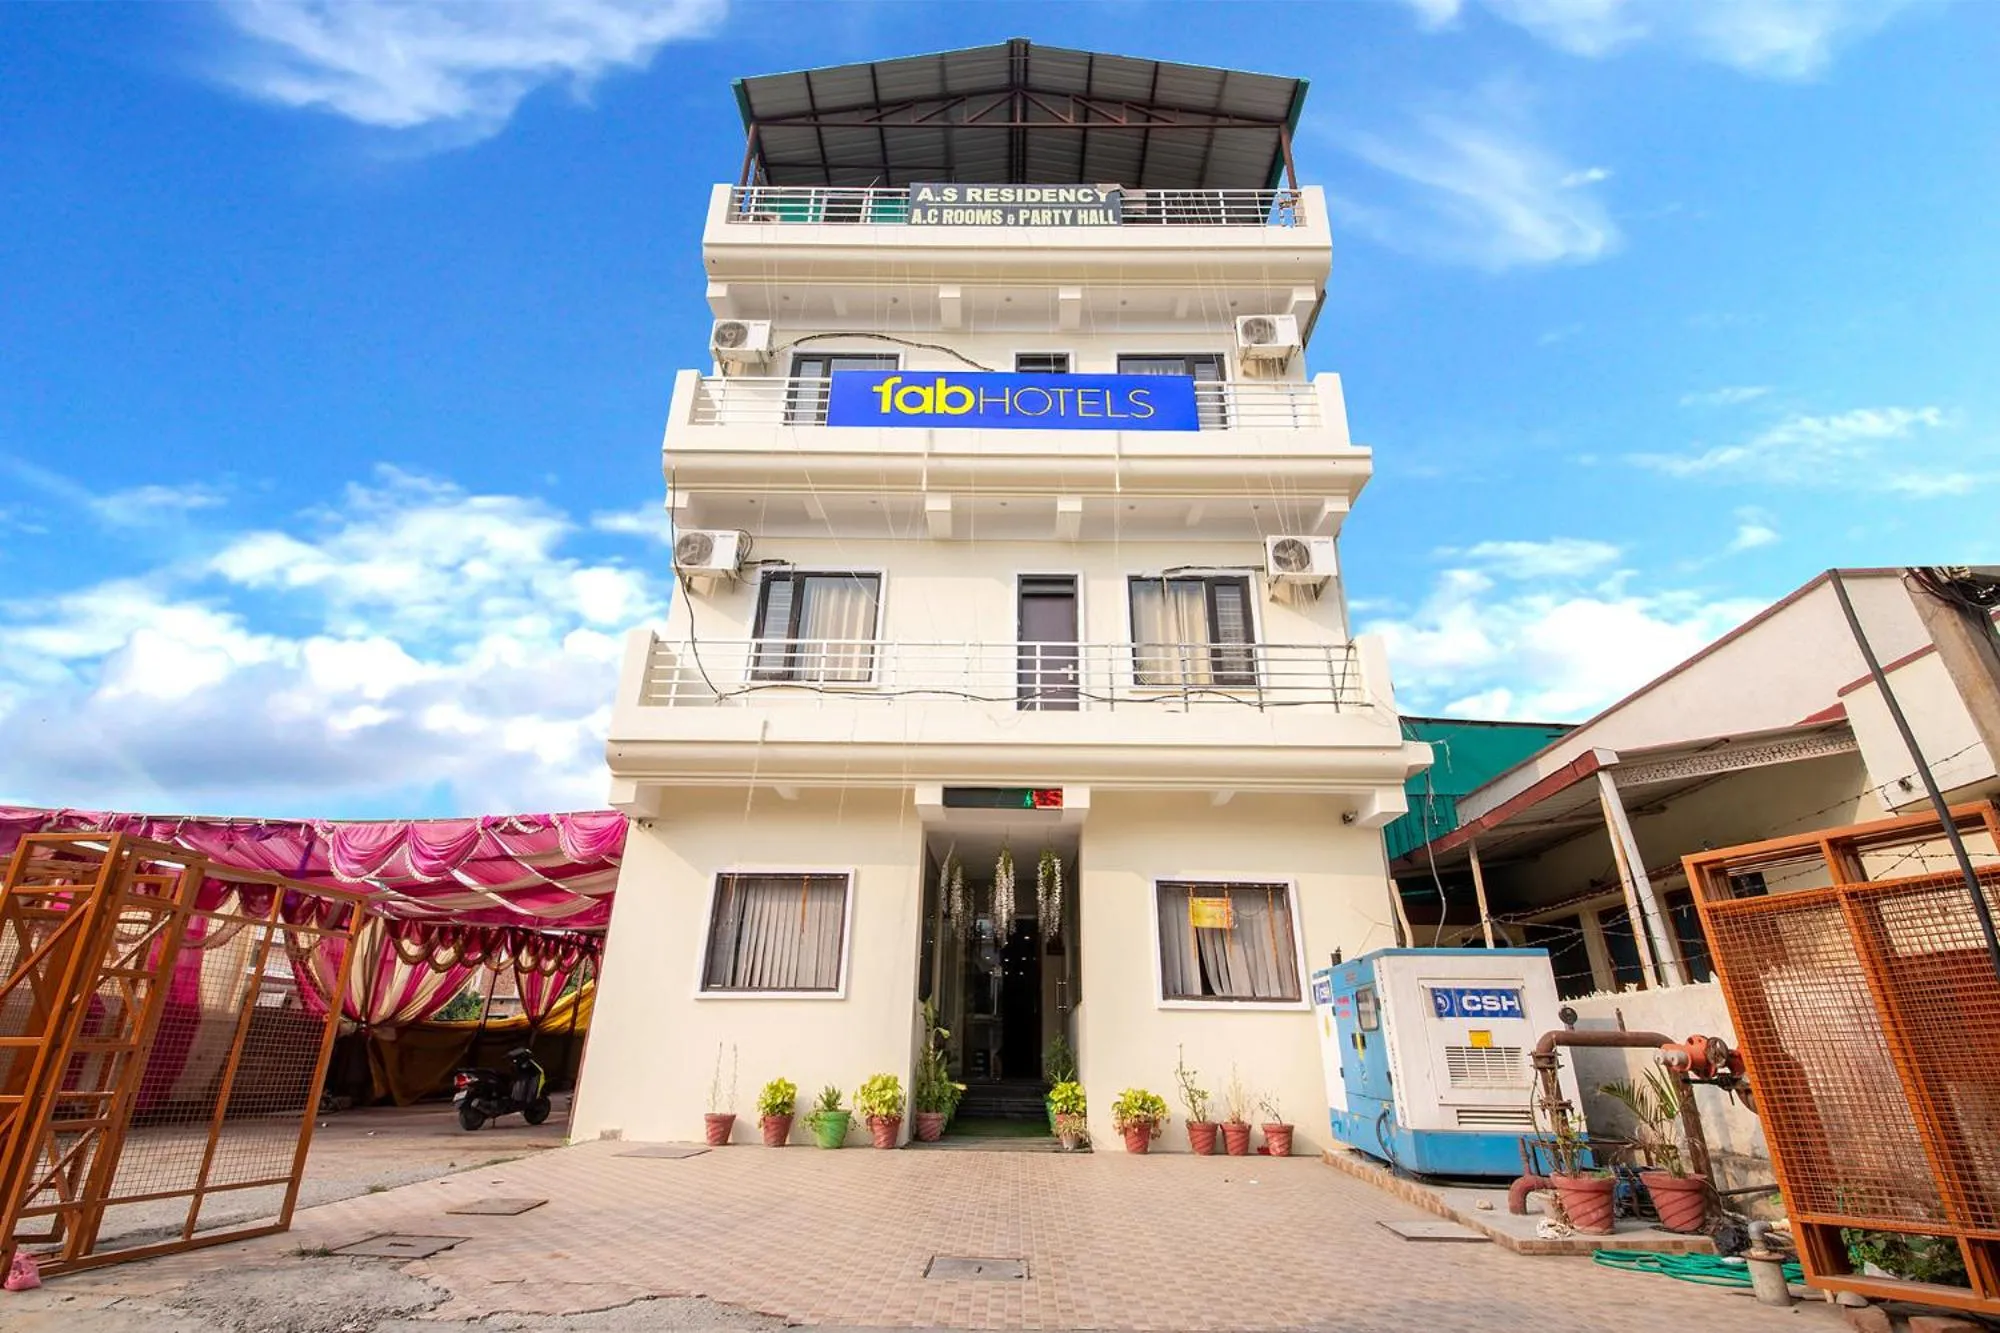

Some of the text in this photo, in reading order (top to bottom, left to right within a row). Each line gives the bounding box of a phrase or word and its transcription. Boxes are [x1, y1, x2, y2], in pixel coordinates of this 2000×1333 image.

[916, 187, 1109, 203] A.S RESIDENCY
[911, 208, 1118, 226] A.C ROOMS & PARTY HALL
[872, 376, 1155, 419] fabHOTELS
[1462, 995, 1521, 1012] CSH
